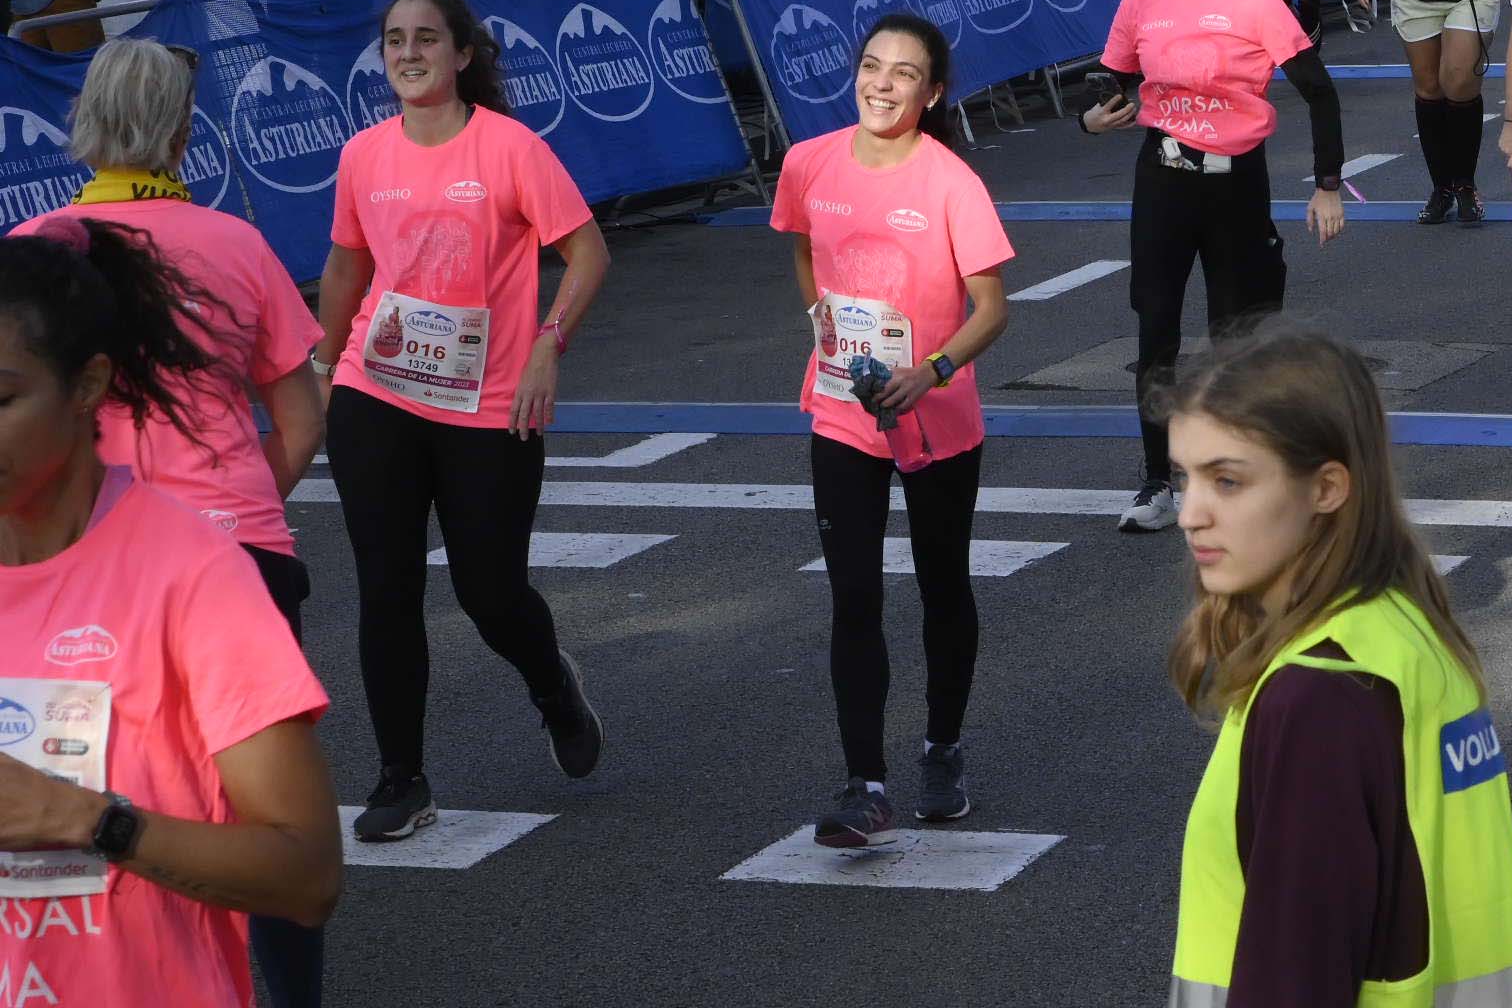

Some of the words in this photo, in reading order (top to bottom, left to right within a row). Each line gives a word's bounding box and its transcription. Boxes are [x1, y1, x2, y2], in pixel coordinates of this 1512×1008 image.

[658, 36, 719, 80] ASTUR
[564, 52, 649, 96] ASTURIANA
[503, 70, 561, 109] URIANA
[1159, 95, 1234, 117] DORSAL
[245, 111, 348, 165] ASTURIANA
[35, 153, 71, 168] LECHER
[0, 173, 84, 226] TURIAN
[371, 189, 412, 203] OYSHO
[810, 197, 852, 216] OYSHO
[408, 316, 453, 333] ASTURIANA
[406, 339, 446, 360] 016
[840, 338, 871, 354] 016
[408, 359, 439, 373] 13749
[433, 391, 470, 403] Santander
[11, 862, 88, 880] Santander
